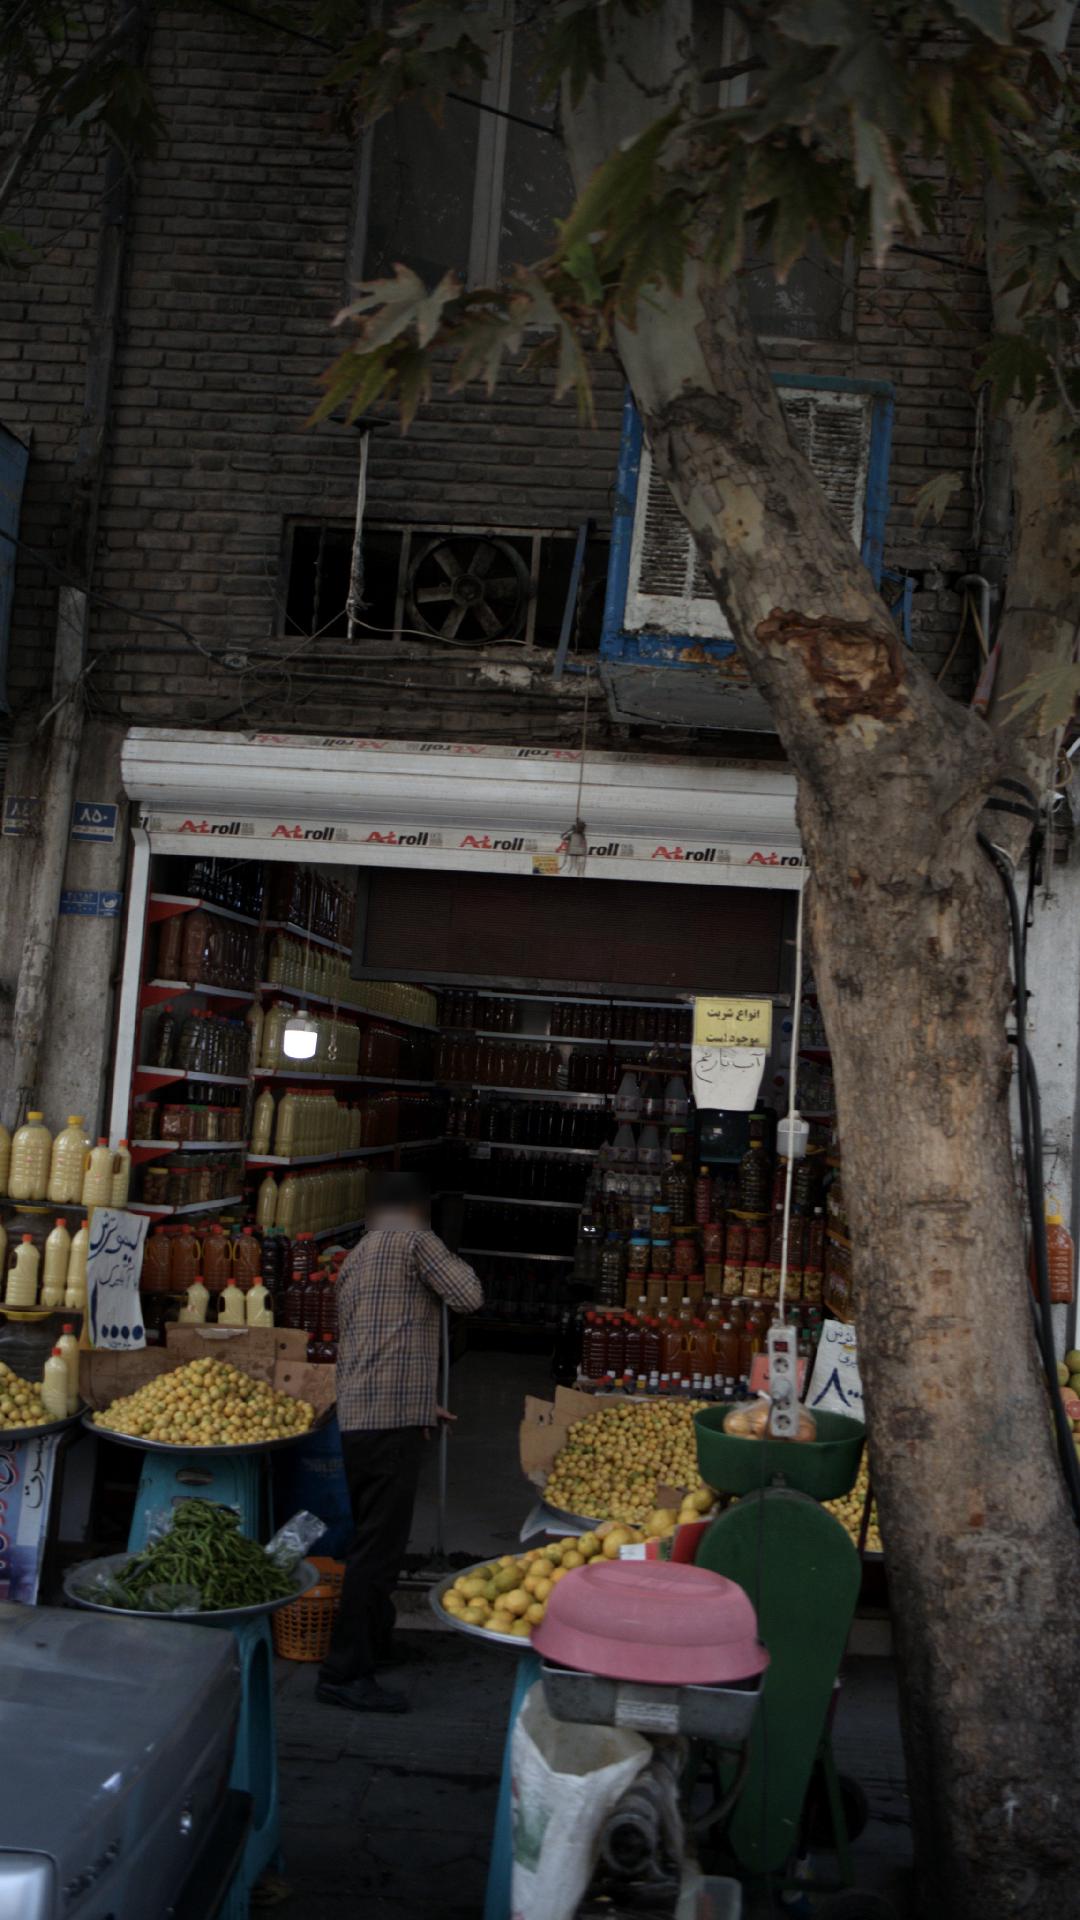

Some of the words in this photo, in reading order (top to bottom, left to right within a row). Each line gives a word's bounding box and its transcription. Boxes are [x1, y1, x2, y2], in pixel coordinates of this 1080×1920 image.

[80, 807, 108, 823] ۸۵۰
[707, 1009, 734, 1021] شربت
[735, 1009, 760, 1021] انواع
[706, 1033, 727, 1042] است
[729, 1036, 760, 1047] موجود
[732, 1052, 764, 1073] آب
[88, 1212, 118, 1260] ترش
[104, 1219, 143, 1263] لیمو
